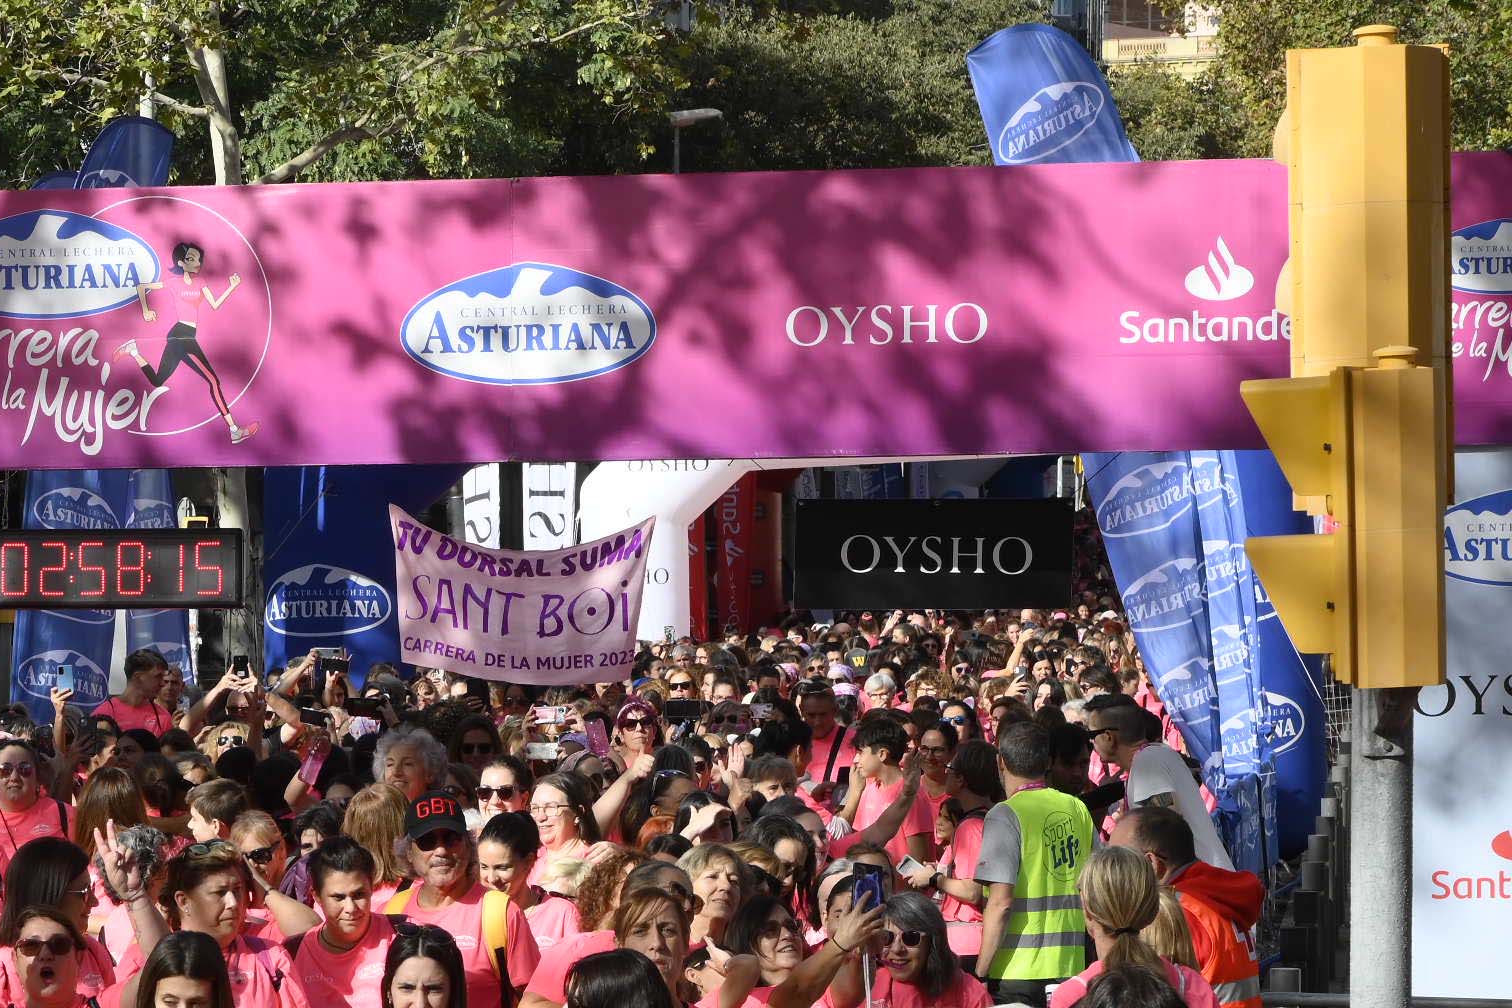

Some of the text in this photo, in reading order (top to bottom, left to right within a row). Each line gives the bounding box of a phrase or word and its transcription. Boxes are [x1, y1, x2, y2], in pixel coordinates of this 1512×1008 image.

[64, 246, 137, 258] LECHERA
[459, 303, 629, 319] CENTRAL LECHERA
[785, 302, 989, 347] OYSHO
[1119, 310, 1292, 344] Santande
[420, 309, 637, 354] ASTURIANA
[1469, 328, 1488, 358] la
[2, 370, 26, 410] la
[21, 362, 170, 456] Mujer
[396, 520, 643, 578] TU DORSAL SUMA
[839, 534, 1033, 576] OYSHO
[0, 541, 223, 596] 02:58:15
[268, 593, 382, 620] ASTURIANA
[281, 588, 324, 598] CENTRAL
[405, 574, 526, 637] SANT
[403, 636, 635, 671] CARRERA DE LA MUJER 2023
[416, 797, 457, 819] GBT
[1044, 817, 1075, 847] Sport
